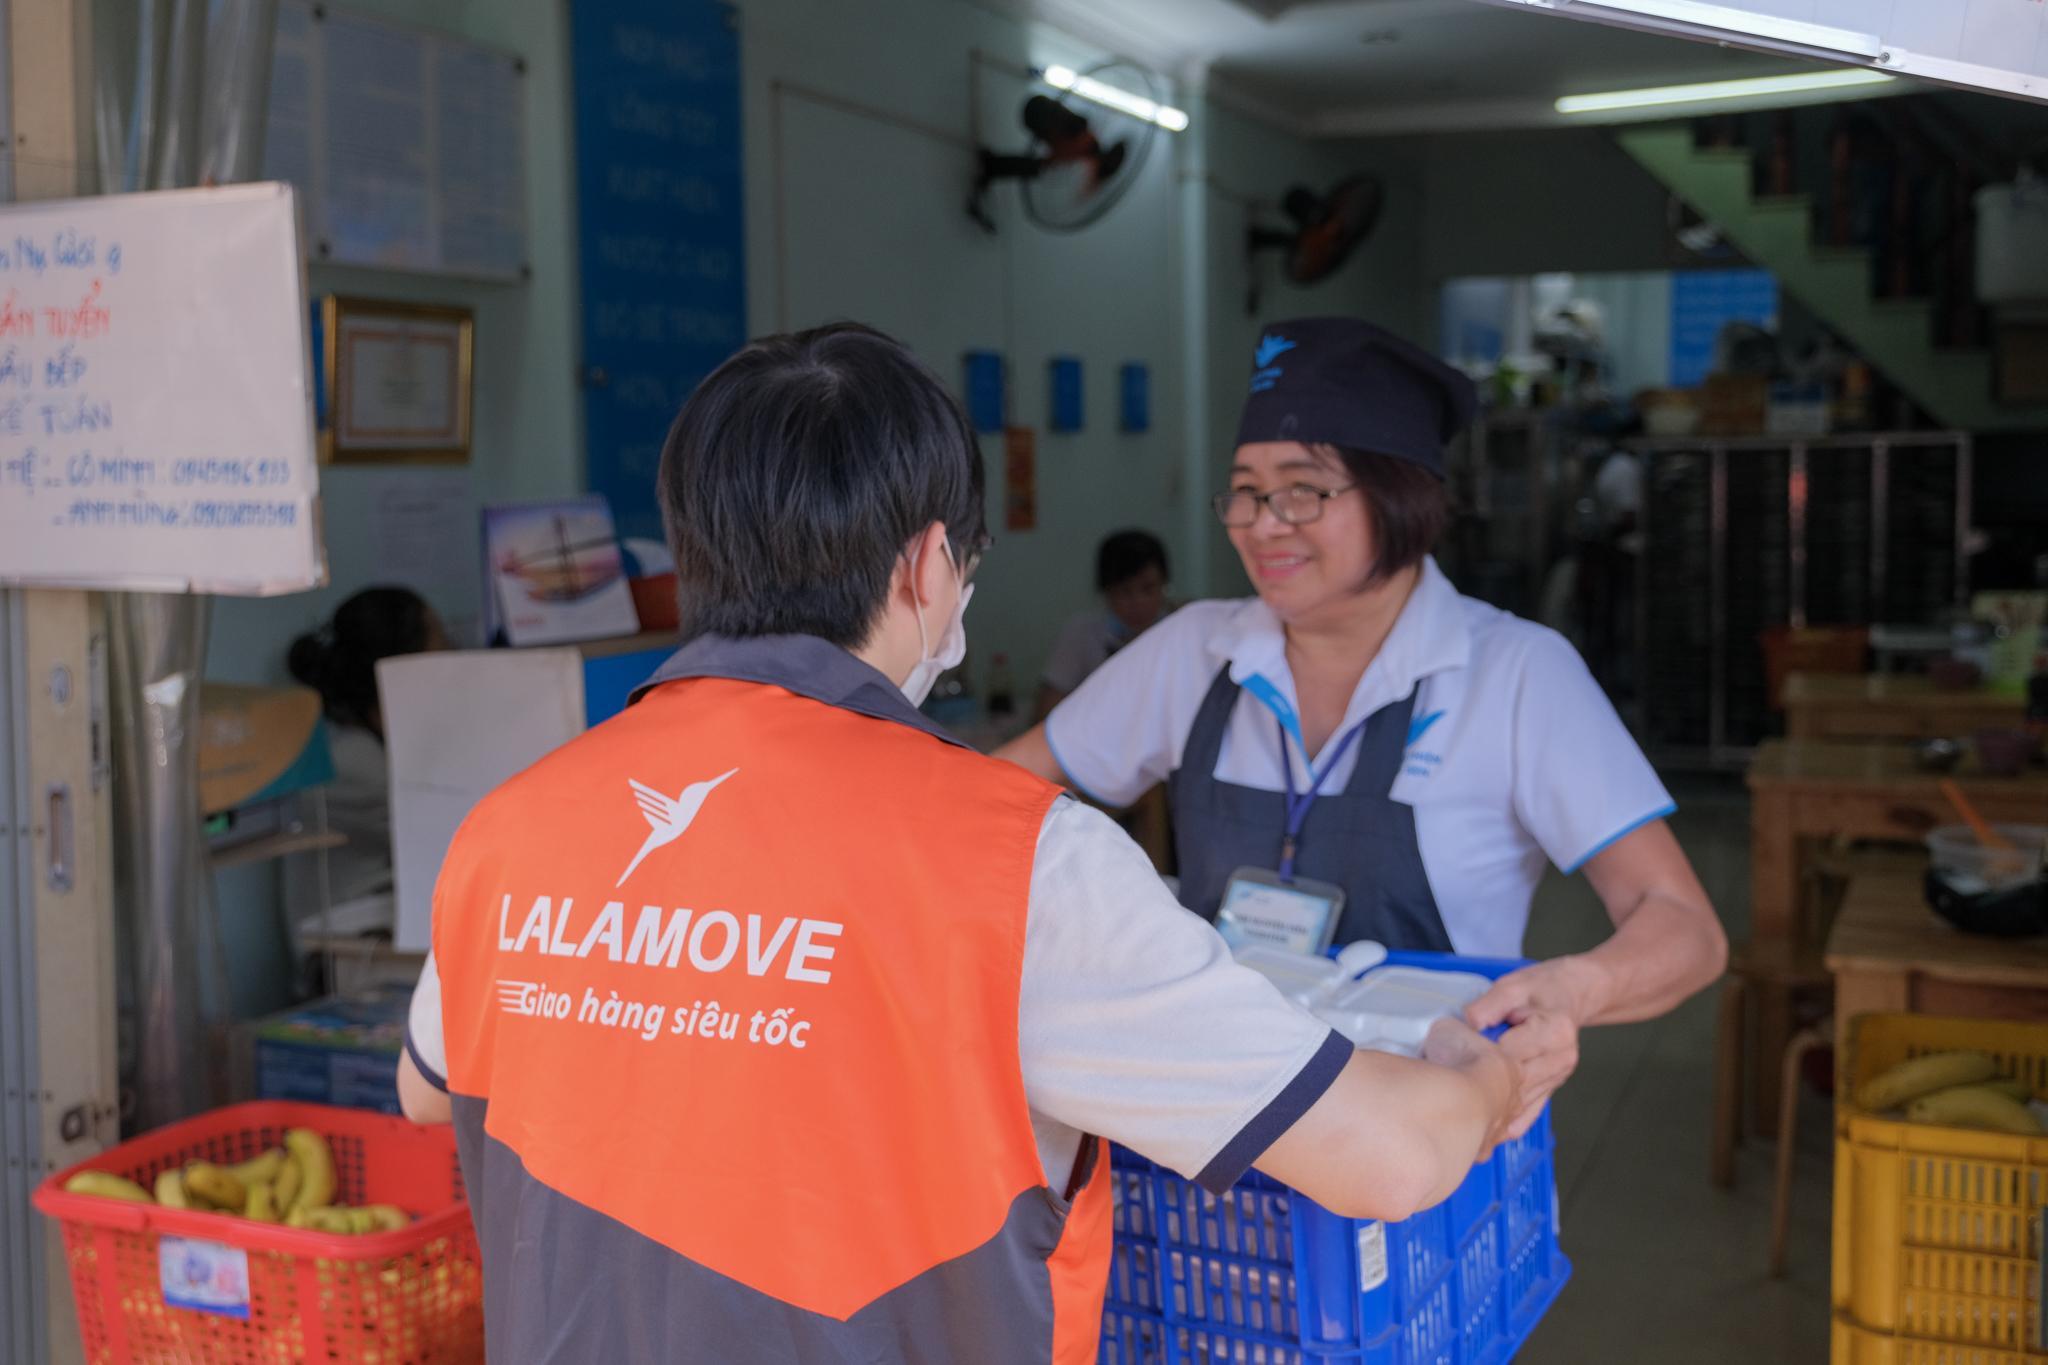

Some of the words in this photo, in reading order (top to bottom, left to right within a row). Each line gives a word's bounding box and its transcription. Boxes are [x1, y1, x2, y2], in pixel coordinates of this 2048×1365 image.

[498, 893, 844, 985] LALAMOVE
[518, 981, 572, 1020] Giao
[577, 987, 666, 1041] hàng
[671, 1000, 740, 1040] siêu
[748, 1007, 811, 1049] tốc
